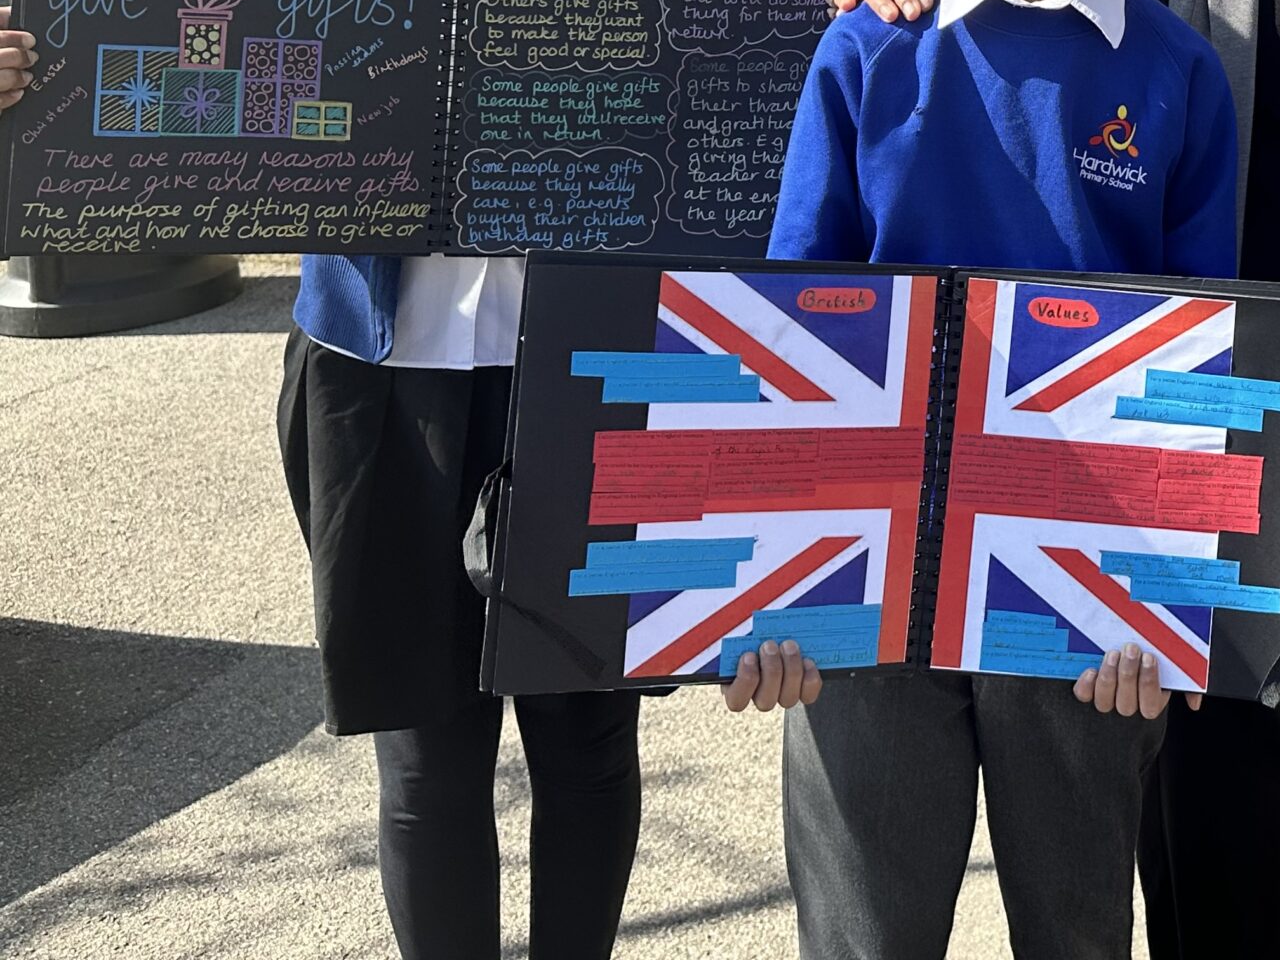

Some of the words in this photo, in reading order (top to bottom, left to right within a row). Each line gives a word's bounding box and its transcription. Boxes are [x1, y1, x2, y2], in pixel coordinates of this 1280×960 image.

[485, 9, 558, 24] because
[564, 13, 602, 33] they
[604, 14, 644, 27] want
[488, 26, 504, 39] to
[511, 27, 560, 40] make
[567, 27, 597, 41] the
[602, 30, 648, 45] person
[367, 46, 429, 80] Birthdays
[483, 41, 518, 57] feel
[528, 43, 569, 64] good
[574, 46, 591, 56] or
[30, 56, 67, 92] Easter
[44, 148, 114, 169] There
[128, 151, 169, 169] are
[179, 150, 248, 171] many
[259, 150, 356, 169] reasons
[363, 146, 414, 174] why
[1073, 147, 1147, 185] Hardwick
[36, 170, 131, 201] people
[135, 171, 199, 205] give
[207, 168, 263, 191] and
[267, 173, 352, 193] receive
[1080, 169, 1108, 186] Primary
[1108, 178, 1133, 191] School
[22, 202, 69, 220] The
[78, 203, 182, 225] purpose
[193, 196, 221, 222] of
[223, 197, 310, 226] gifting
[314, 204, 348, 219] can
[353, 199, 431, 223] influence
[96, 221, 139, 238] and
[146, 221, 190, 239] how
[199, 224, 231, 239] we
[238, 220, 309, 239] choose
[318, 221, 338, 238] to
[341, 222, 394, 244] give
[396, 224, 424, 237] or
[1037, 302, 1091, 324] Values
